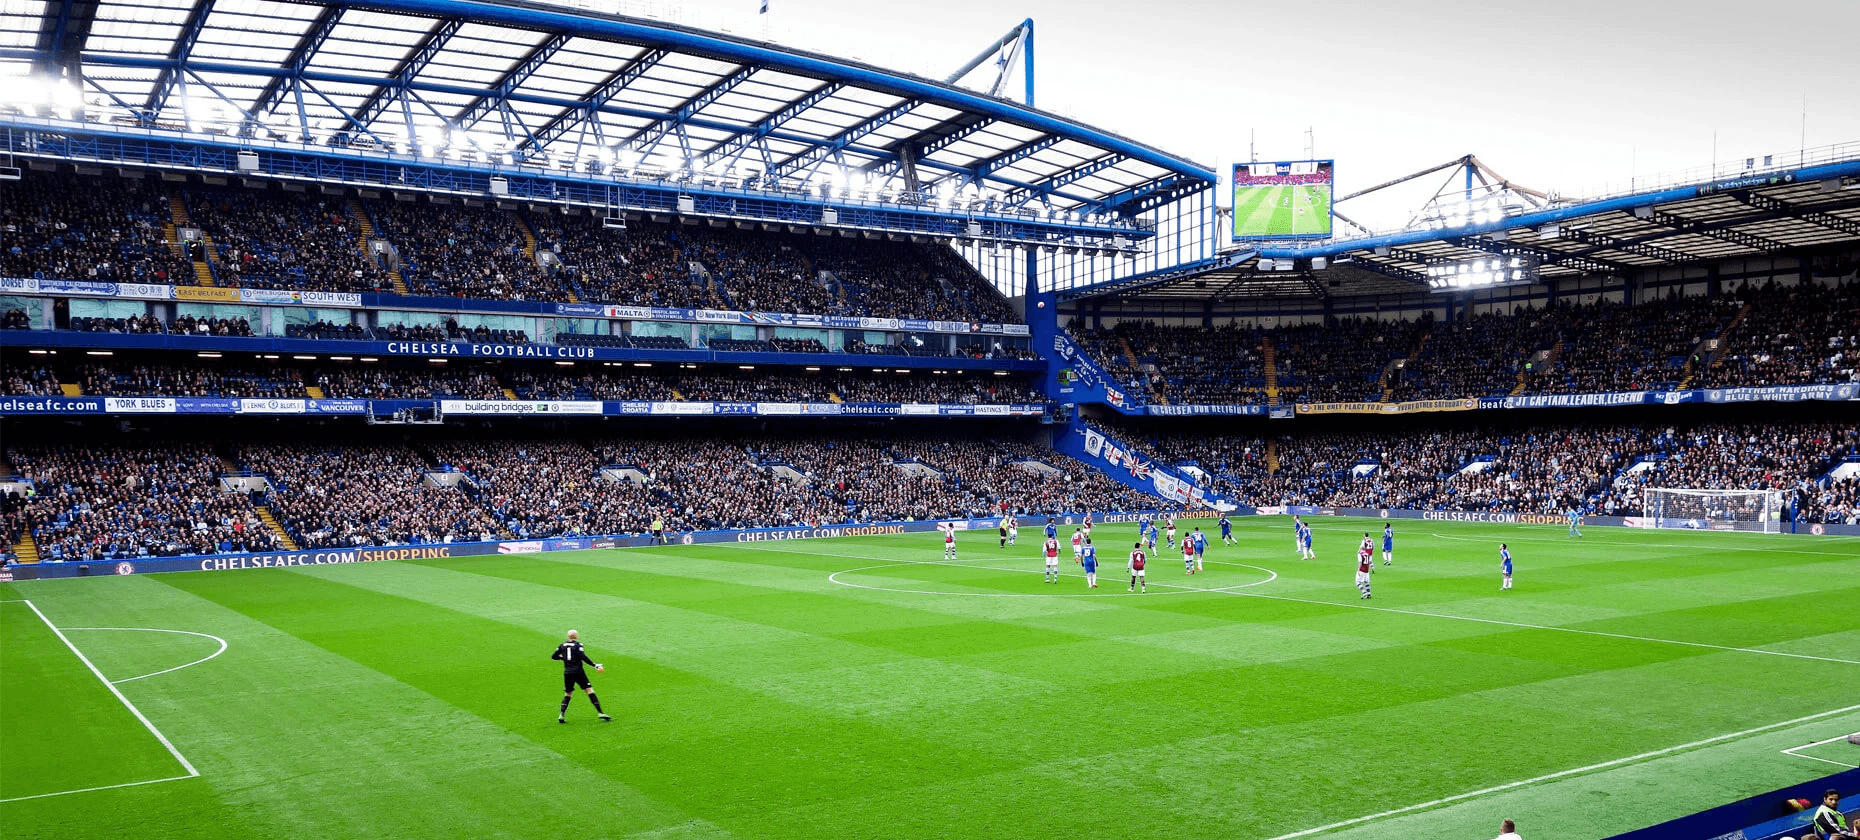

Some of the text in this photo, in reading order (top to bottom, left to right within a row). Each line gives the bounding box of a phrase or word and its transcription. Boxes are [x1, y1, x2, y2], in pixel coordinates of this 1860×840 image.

[1, 278, 24, 288] DORSET
[303, 292, 360, 302] SOUTH WEST
[388, 342, 594, 358] CHELSEA FOOTBALL CLUB
[1516, 396, 1527, 406] JT
[1725, 393, 1750, 401] BLUE
[1761, 393, 1795, 401] WHITE
[1800, 391, 1832, 400] ARMY
[0, 399, 98, 411] elseafc.com
[115, 399, 166, 409] YORK BLUES
[465, 402, 533, 412] building bridges
[841, 404, 901, 414] chelseafc.com
[1434, 400, 1464, 408] SATURDAY
[1160, 405, 1248, 415] CHELSEA OUR RELIGION
[738, 524, 904, 543] CHELSEAFC.COM/SHOPPING
[1049, 540, 1055, 549] 16
[201, 547, 450, 571] CHELSEAFC.COM/SHOPPING
[566, 647, 572, 661] 1
